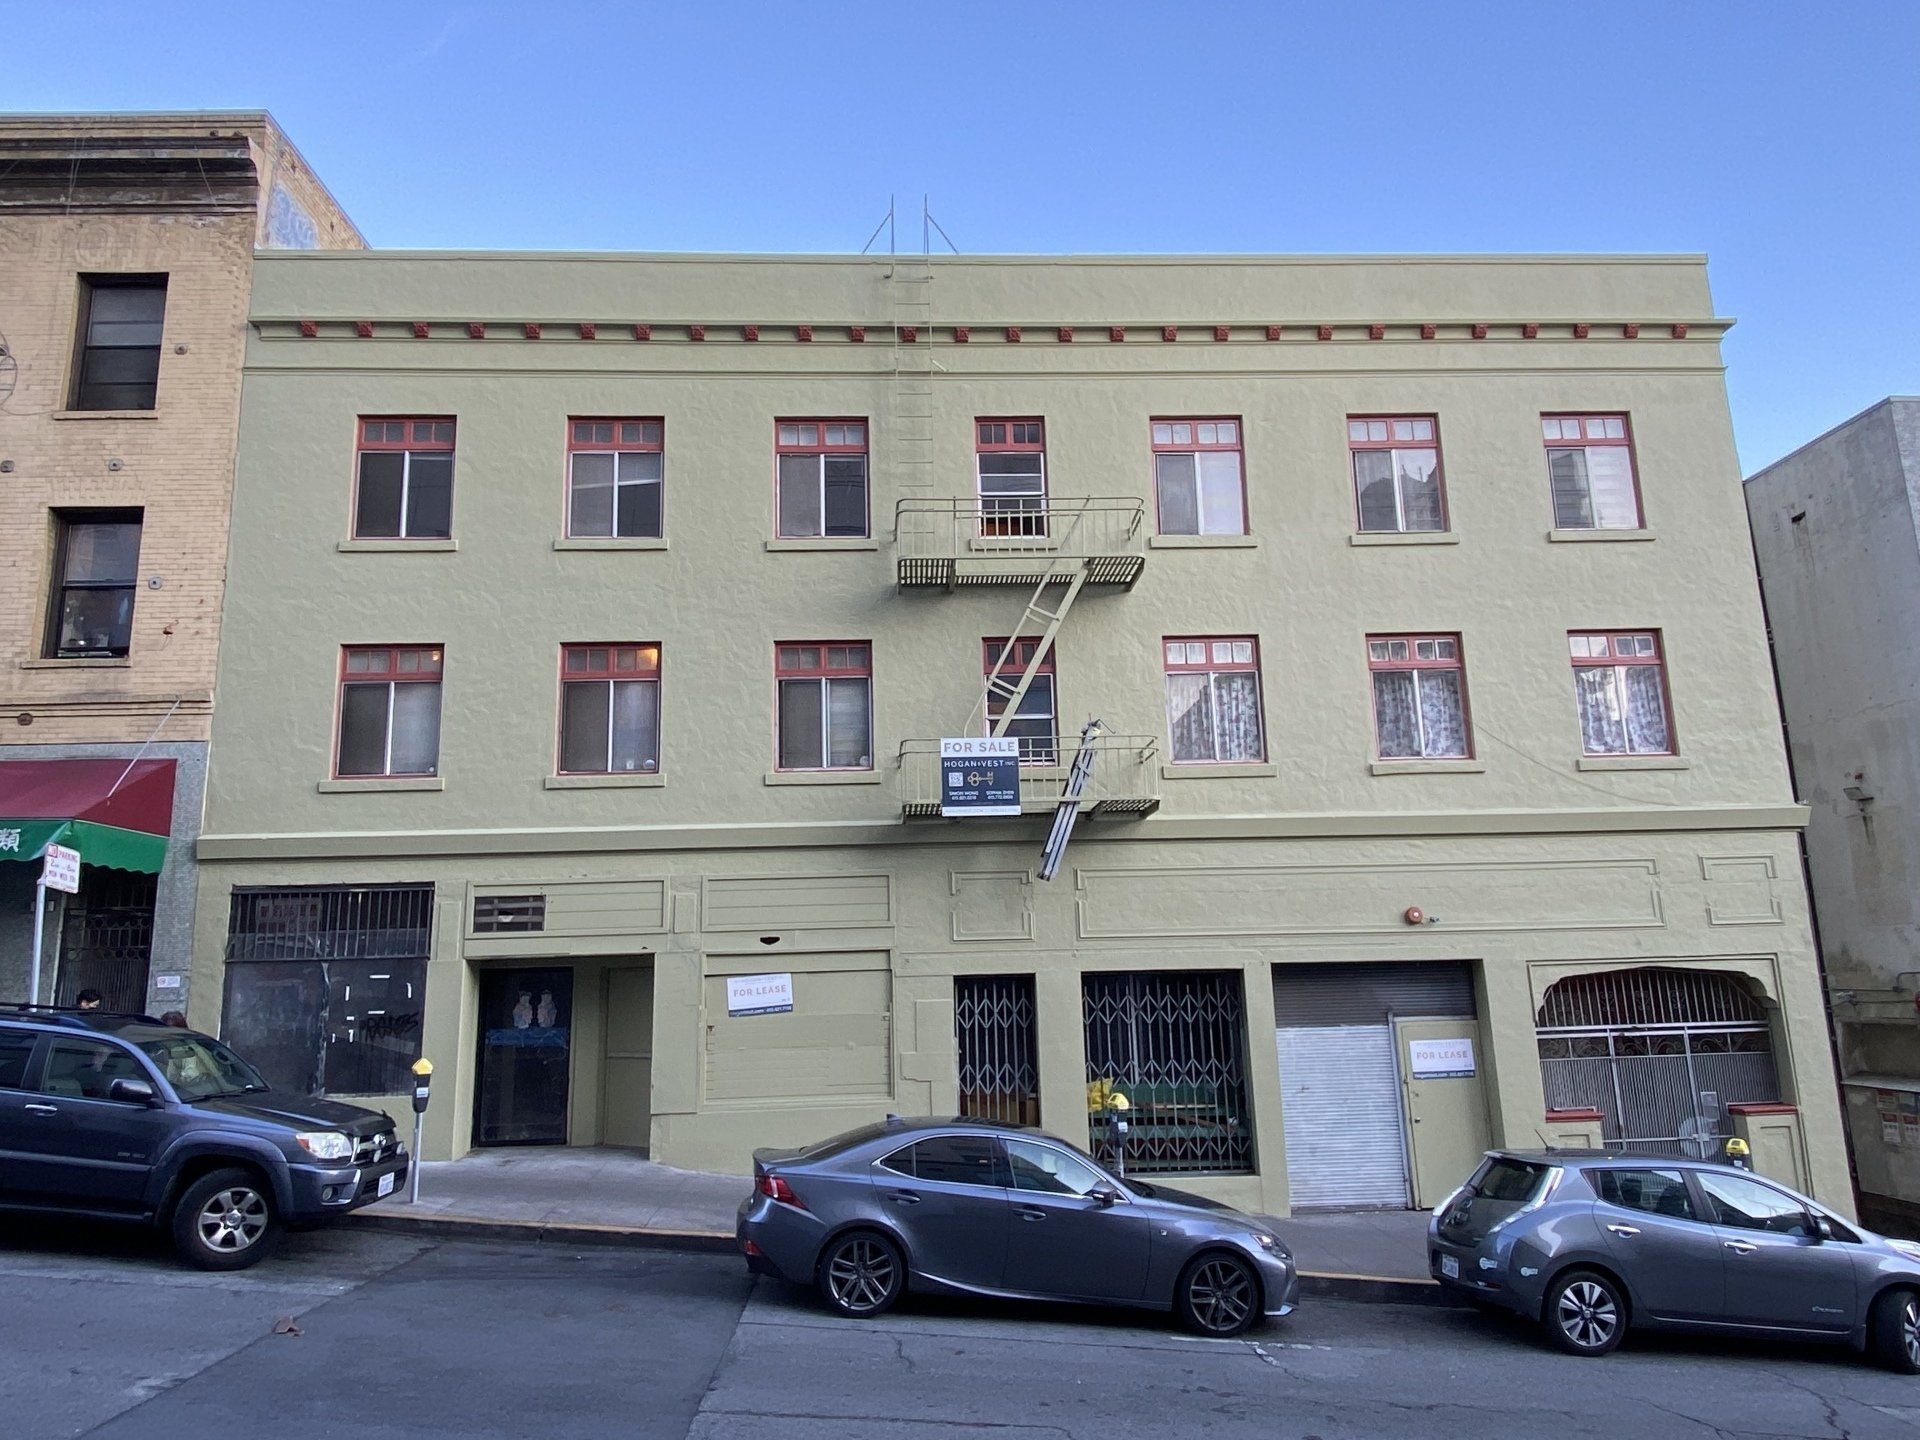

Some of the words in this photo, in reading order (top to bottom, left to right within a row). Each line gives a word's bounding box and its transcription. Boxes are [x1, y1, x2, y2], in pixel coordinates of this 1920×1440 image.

[944, 743, 972, 753] FOR
[979, 742, 1015, 752] SALE
[58, 850, 78, 863] PARKING
[733, 988, 753, 997] FOR
[756, 984, 787, 995] LEASE
[1416, 1051, 1435, 1060] FOR
[1438, 1050, 1469, 1060] LEASE
